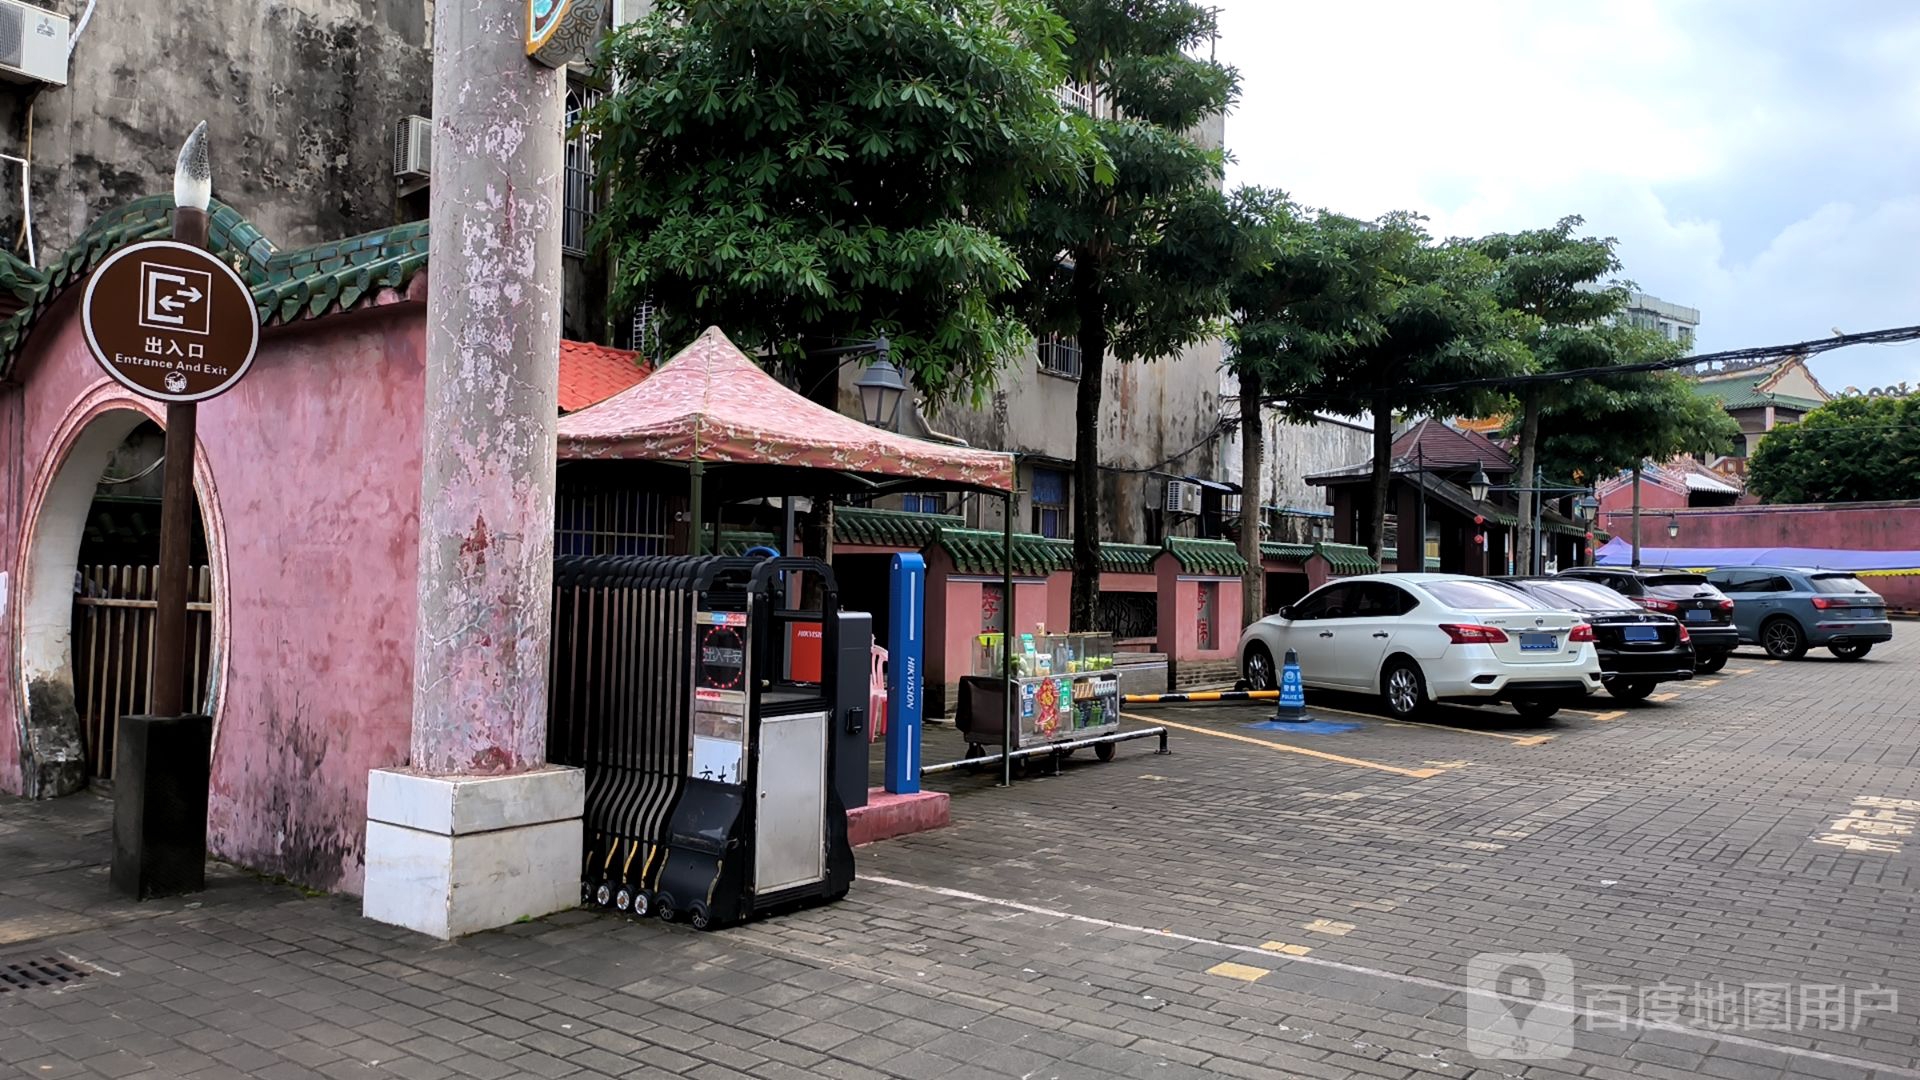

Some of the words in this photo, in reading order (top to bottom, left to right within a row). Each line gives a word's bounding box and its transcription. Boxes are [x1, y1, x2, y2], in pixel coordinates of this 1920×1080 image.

[144, 336, 204, 359] 出入口
[115, 353, 173, 369] Entrance
[176, 361, 201, 372] And
[203, 364, 228, 376] Exit
[702, 647, 741, 664] 出入平安
[906, 656, 915, 710] HIKVISION
